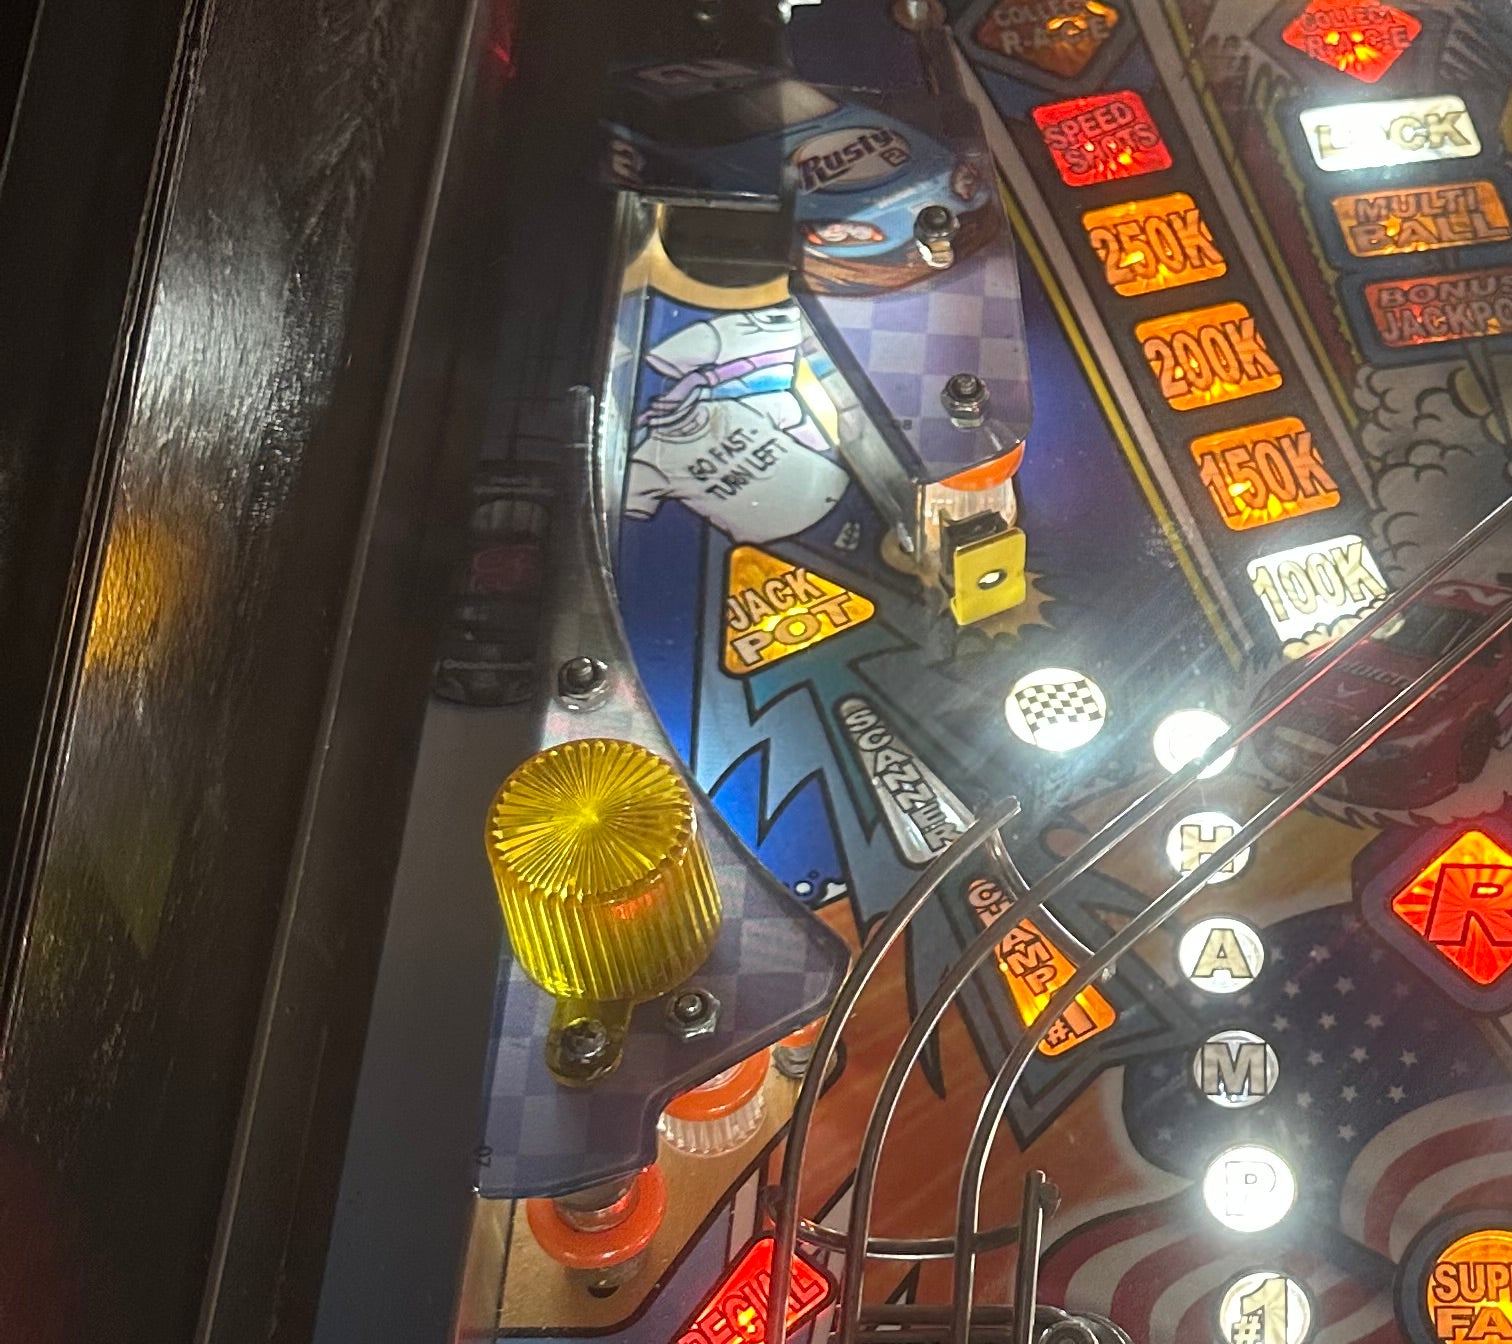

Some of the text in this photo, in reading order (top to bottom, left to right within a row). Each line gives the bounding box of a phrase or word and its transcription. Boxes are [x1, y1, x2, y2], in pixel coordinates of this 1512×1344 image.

[801, 125, 898, 193] Rusty
[1045, 102, 1135, 152] SPEED
[1063, 123, 1160, 178] SHOTS
[1315, 111, 1479, 160] LCK
[1355, 187, 1477, 221] MULTI
[1091, 208, 1225, 285] 250K
[1145, 317, 1280, 398] 200K
[687, 427, 760, 482] GO FAST-
[705, 437, 789, 501] TURN LEFT
[1200, 431, 1340, 519] 150K
[728, 566, 821, 632] JACK
[1249, 542, 1388, 623] 100K
[731, 592, 857, 666] POT
[843, 709, 963, 854] SCANNER
